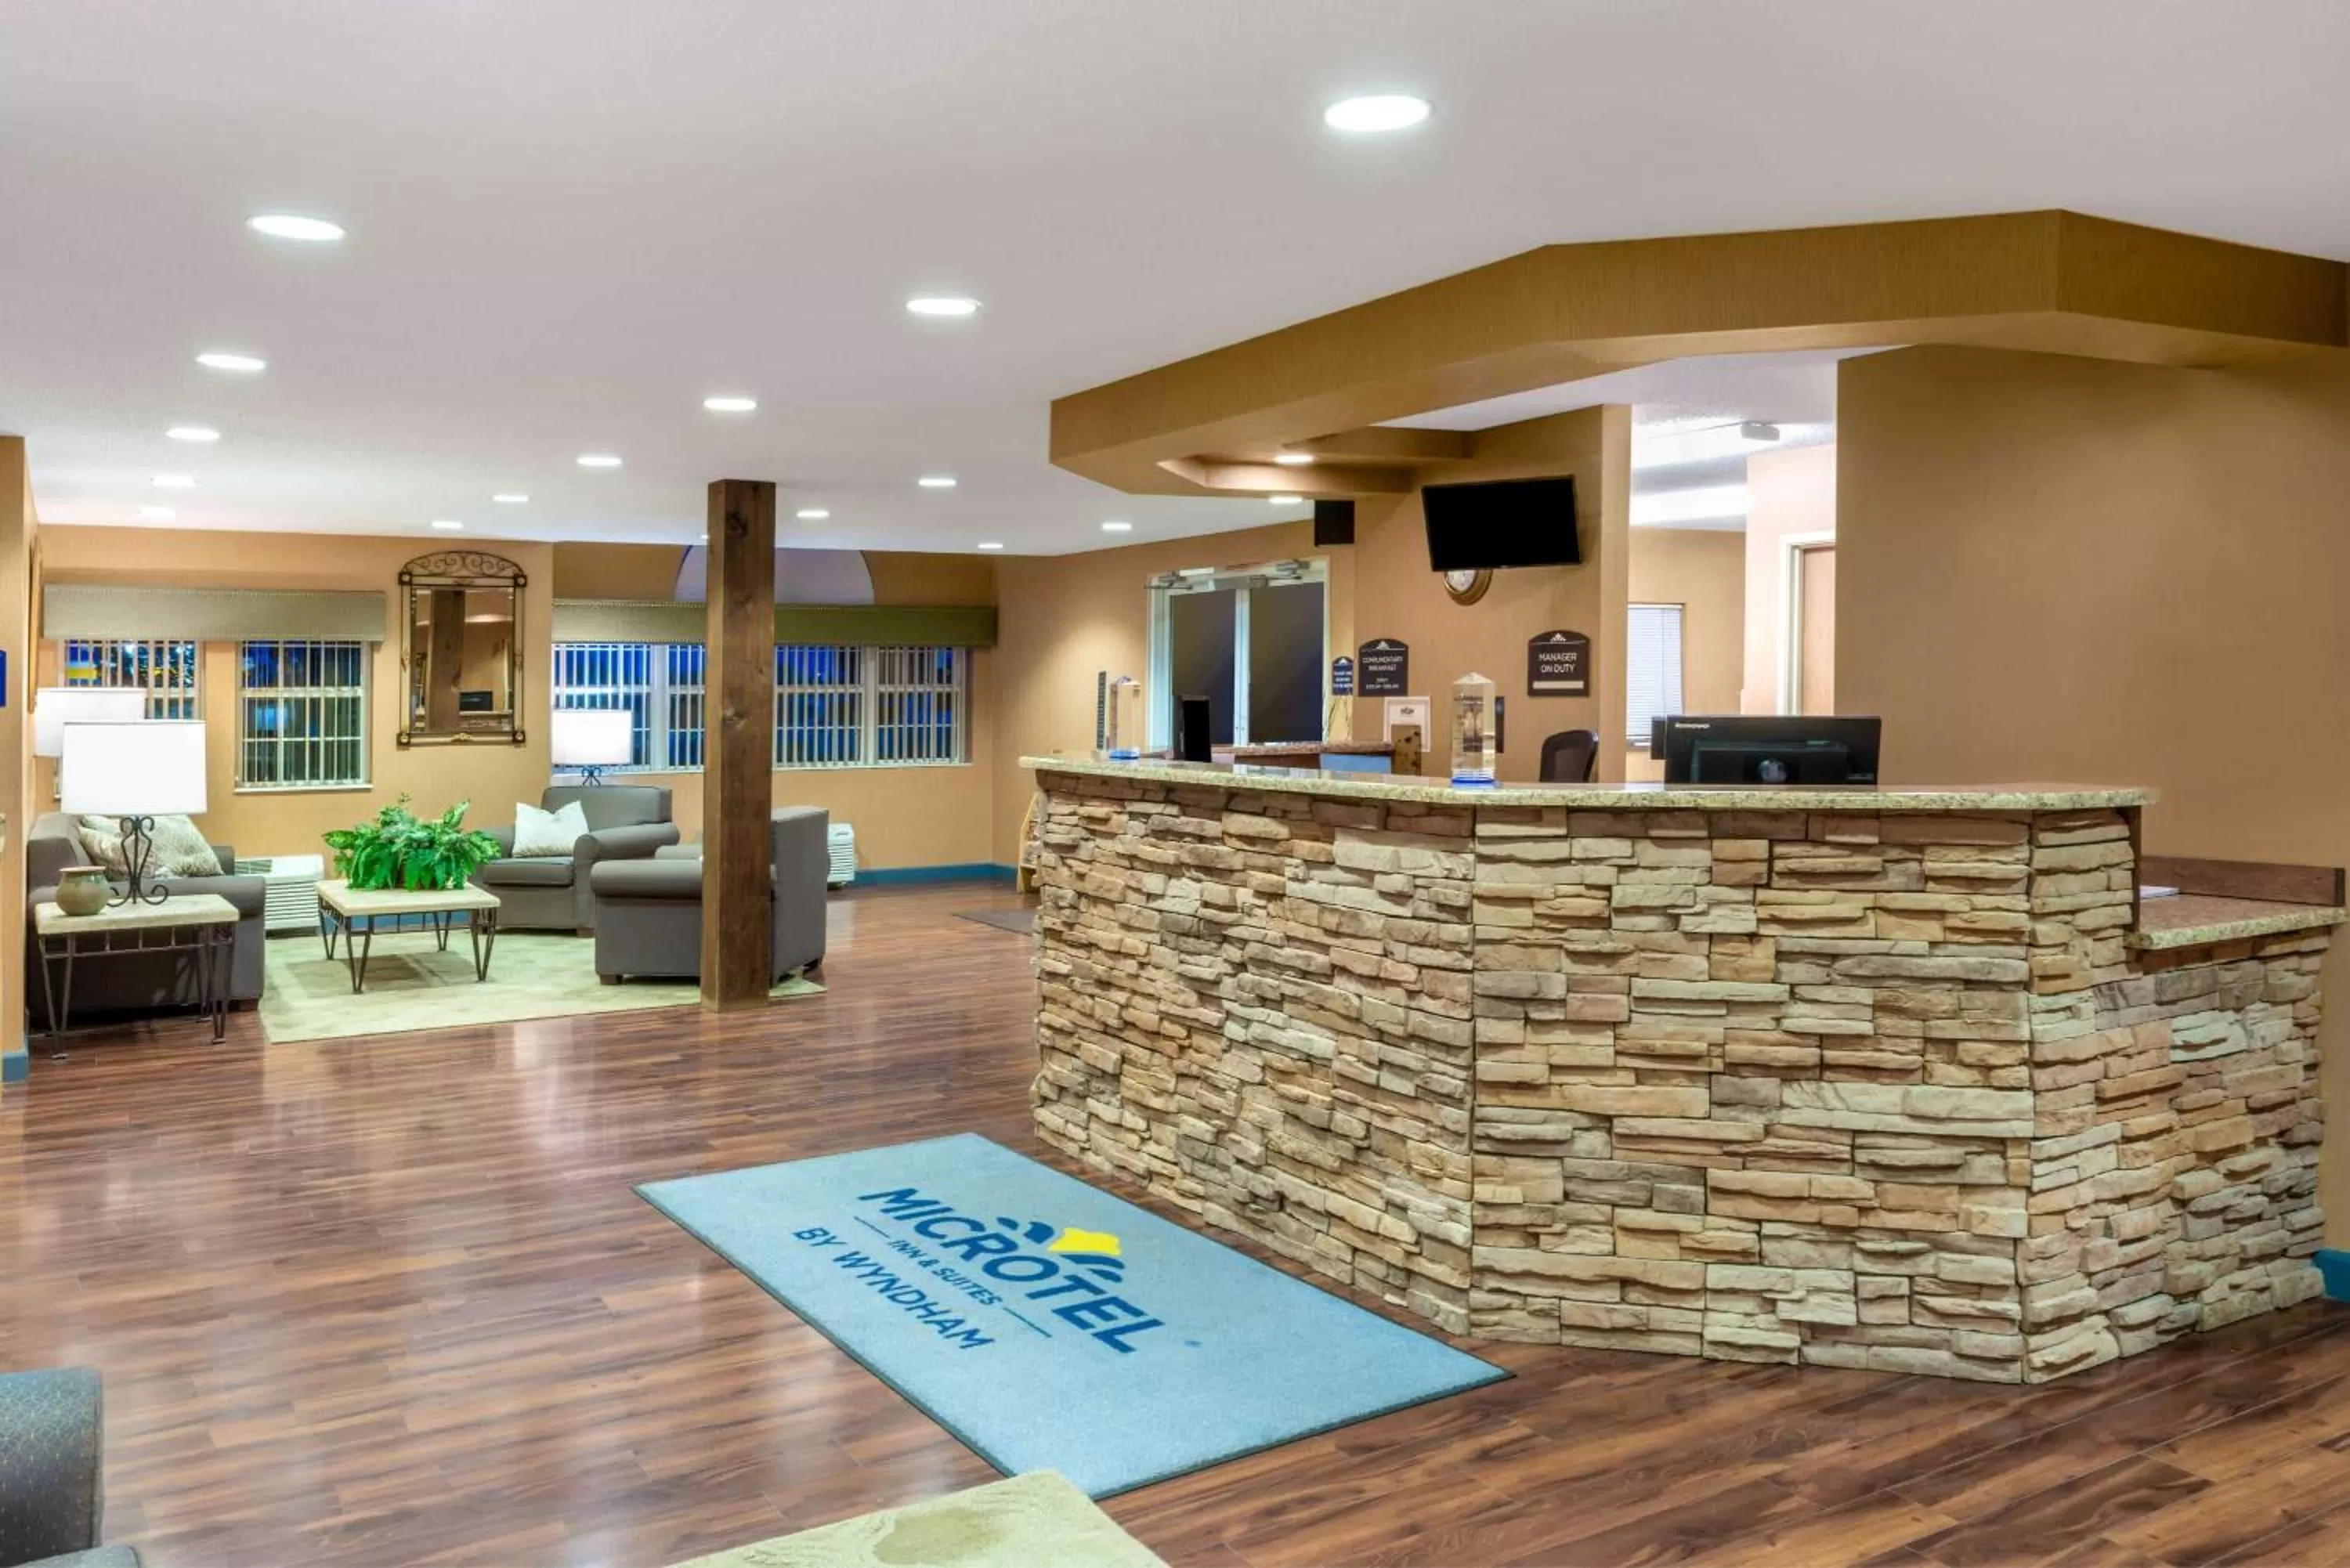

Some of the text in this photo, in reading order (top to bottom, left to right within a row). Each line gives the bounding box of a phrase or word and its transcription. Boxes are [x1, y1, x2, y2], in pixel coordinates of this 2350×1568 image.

[1538, 652, 1577, 662] MANAGER
[1541, 663, 1575, 673] ON DUTY
[793, 1227, 996, 1350] BY WYNDHAM
[857, 1187, 1166, 1354] MICROTEL
[887, 1239, 1003, 1306] INN & SUITES
